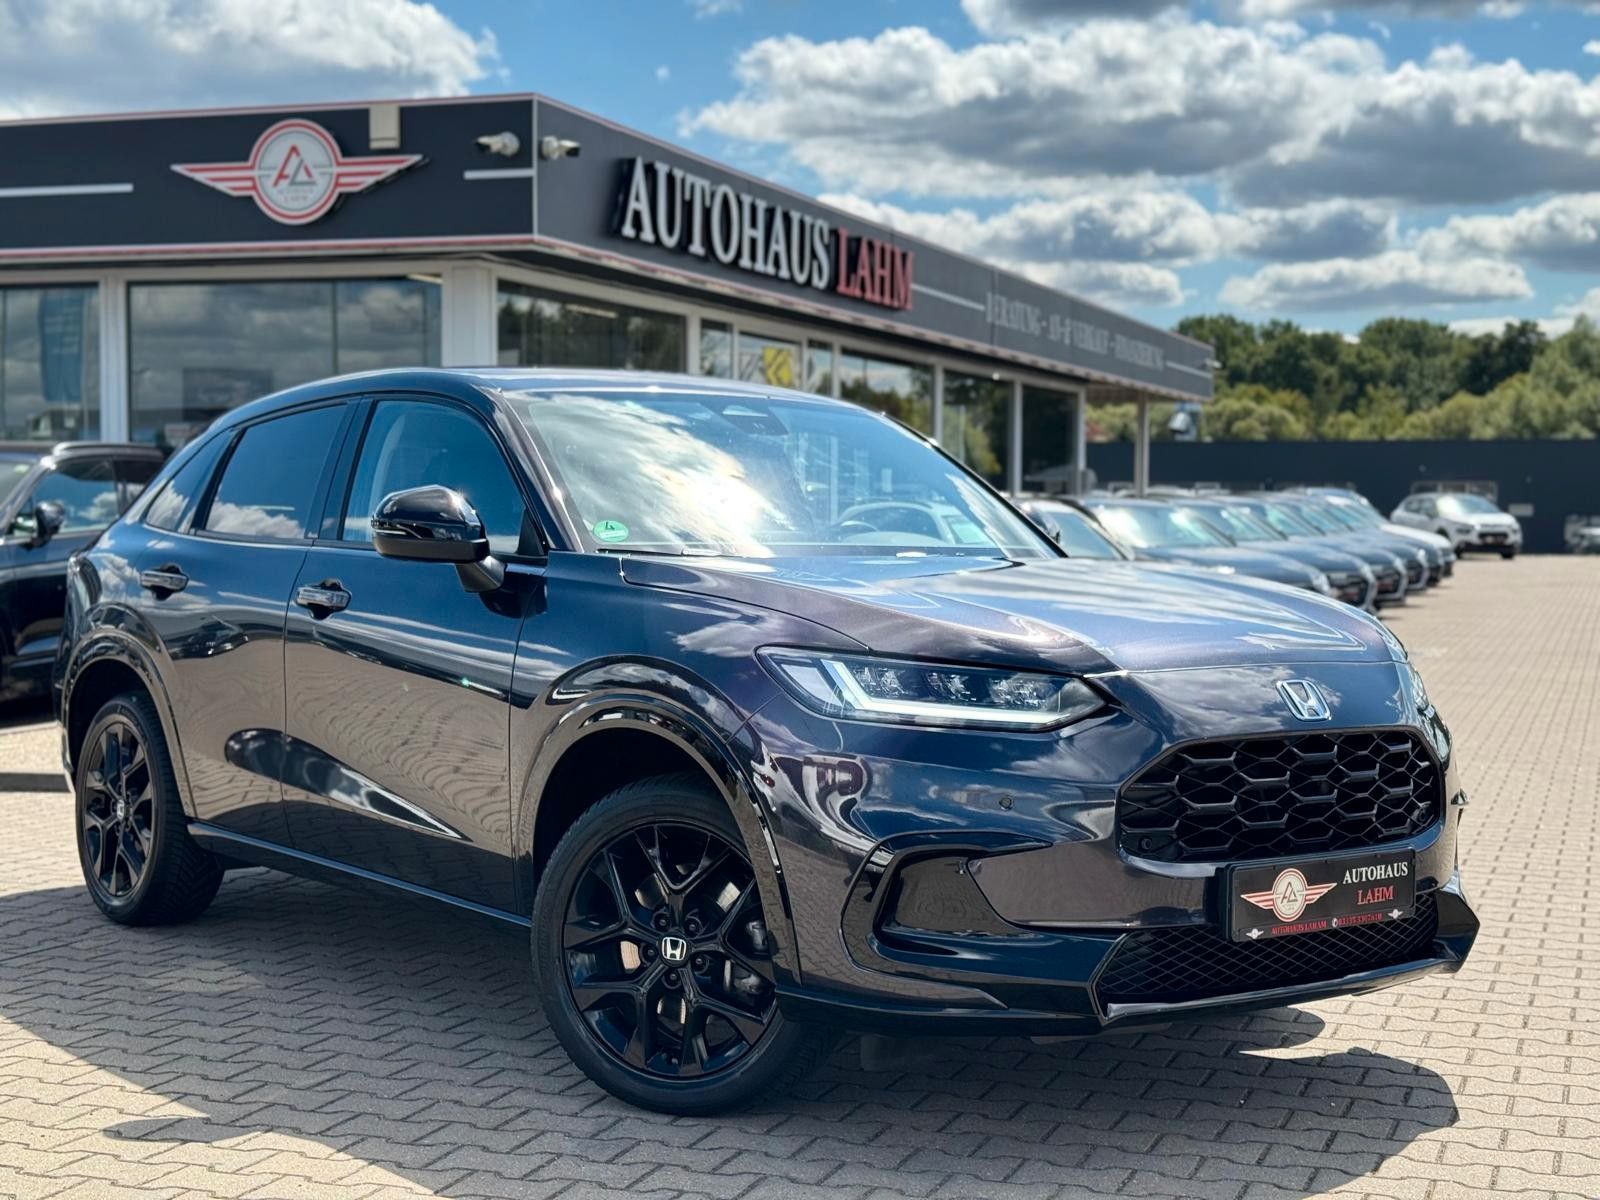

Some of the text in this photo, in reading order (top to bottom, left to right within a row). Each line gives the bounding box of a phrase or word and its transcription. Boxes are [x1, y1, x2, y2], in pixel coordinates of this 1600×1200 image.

[621, 155, 912, 310] AUTOHAUS LAHM
[1342, 861, 1408, 885] AUTOHAUS
[1357, 885, 1394, 905] LAHM
